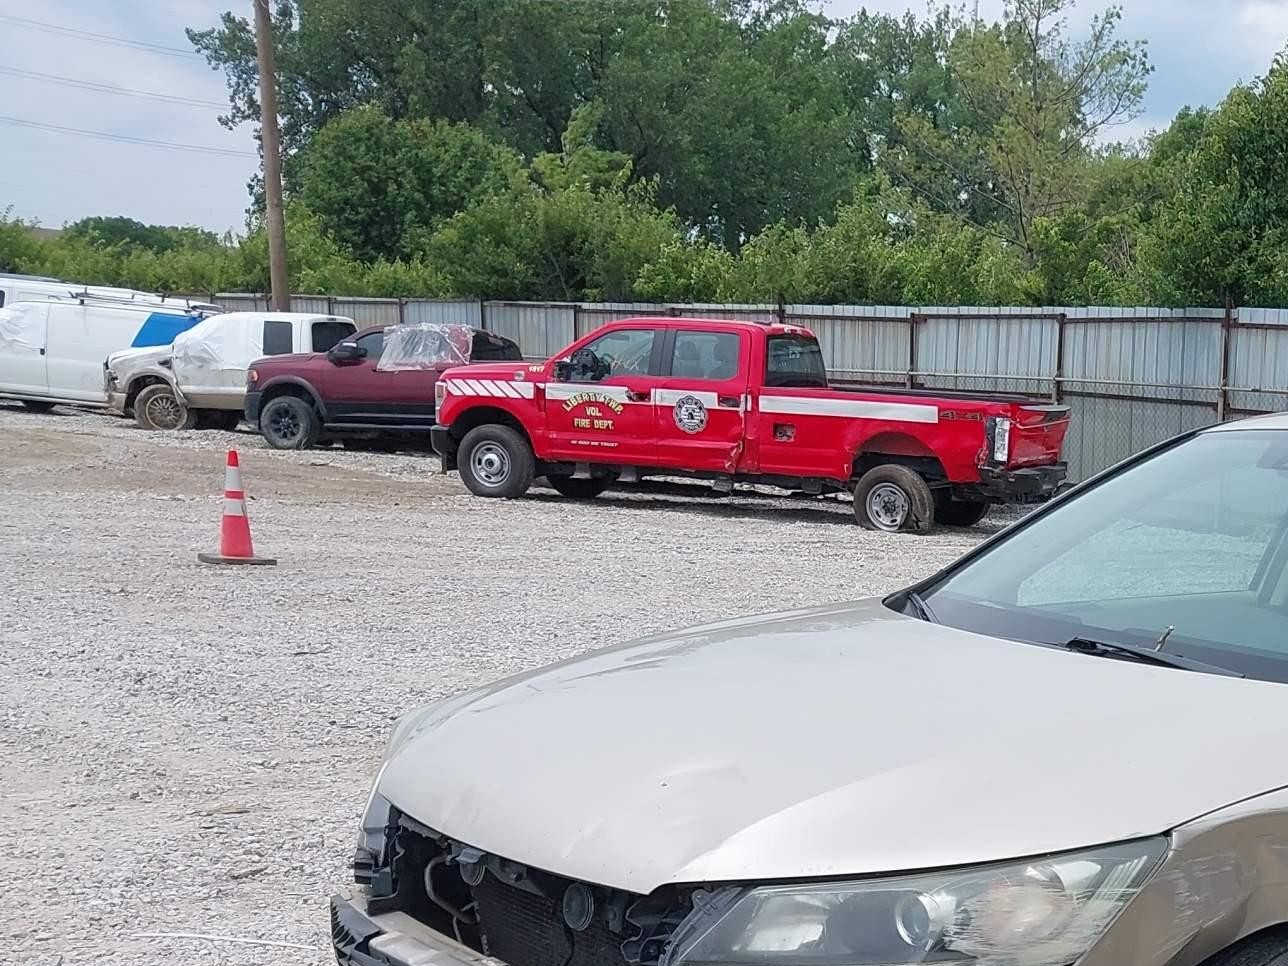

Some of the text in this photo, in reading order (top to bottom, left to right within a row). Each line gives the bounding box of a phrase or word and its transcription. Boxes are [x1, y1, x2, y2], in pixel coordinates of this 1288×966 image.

[562, 392, 625, 415] LIBERTY TWP.
[585, 406, 603, 417] VOL.
[574, 417, 615, 430] FIRE DEPT.
